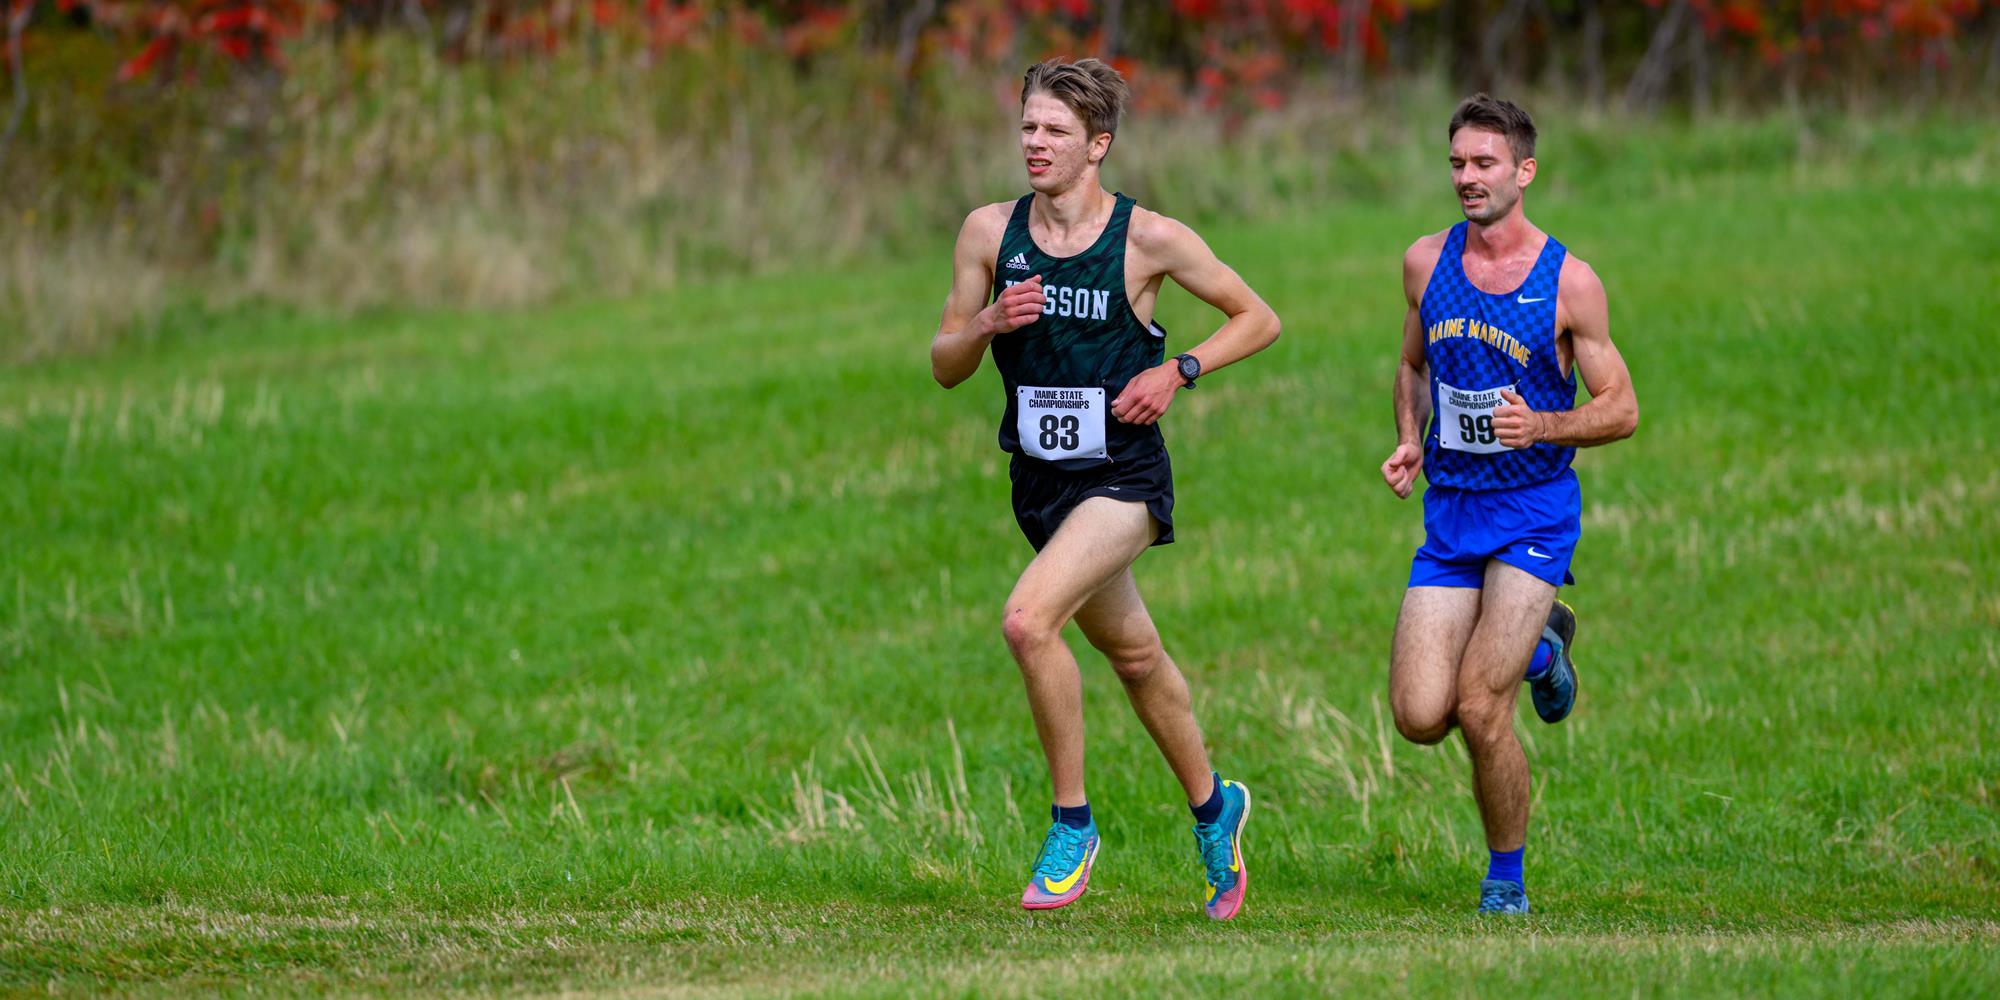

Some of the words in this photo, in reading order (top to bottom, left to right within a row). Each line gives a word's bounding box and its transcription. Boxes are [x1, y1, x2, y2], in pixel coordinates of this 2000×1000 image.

[1005, 261, 1030, 271] adidas
[1005, 280, 1110, 321] SSON
[1429, 318, 1466, 347] MAINE
[1467, 318, 1532, 368] MARITIME
[1034, 390, 1058, 400] MAINE
[1060, 390, 1084, 400] STATE
[1452, 390, 1472, 401] MAINE
[1473, 391, 1496, 402] STATE
[1029, 399, 1090, 410] CHAMPIONSHIPS
[1449, 396, 1503, 410] CHAMPIONSHIPS
[1039, 414, 1080, 451] 83
[1459, 413, 1496, 445] 99
